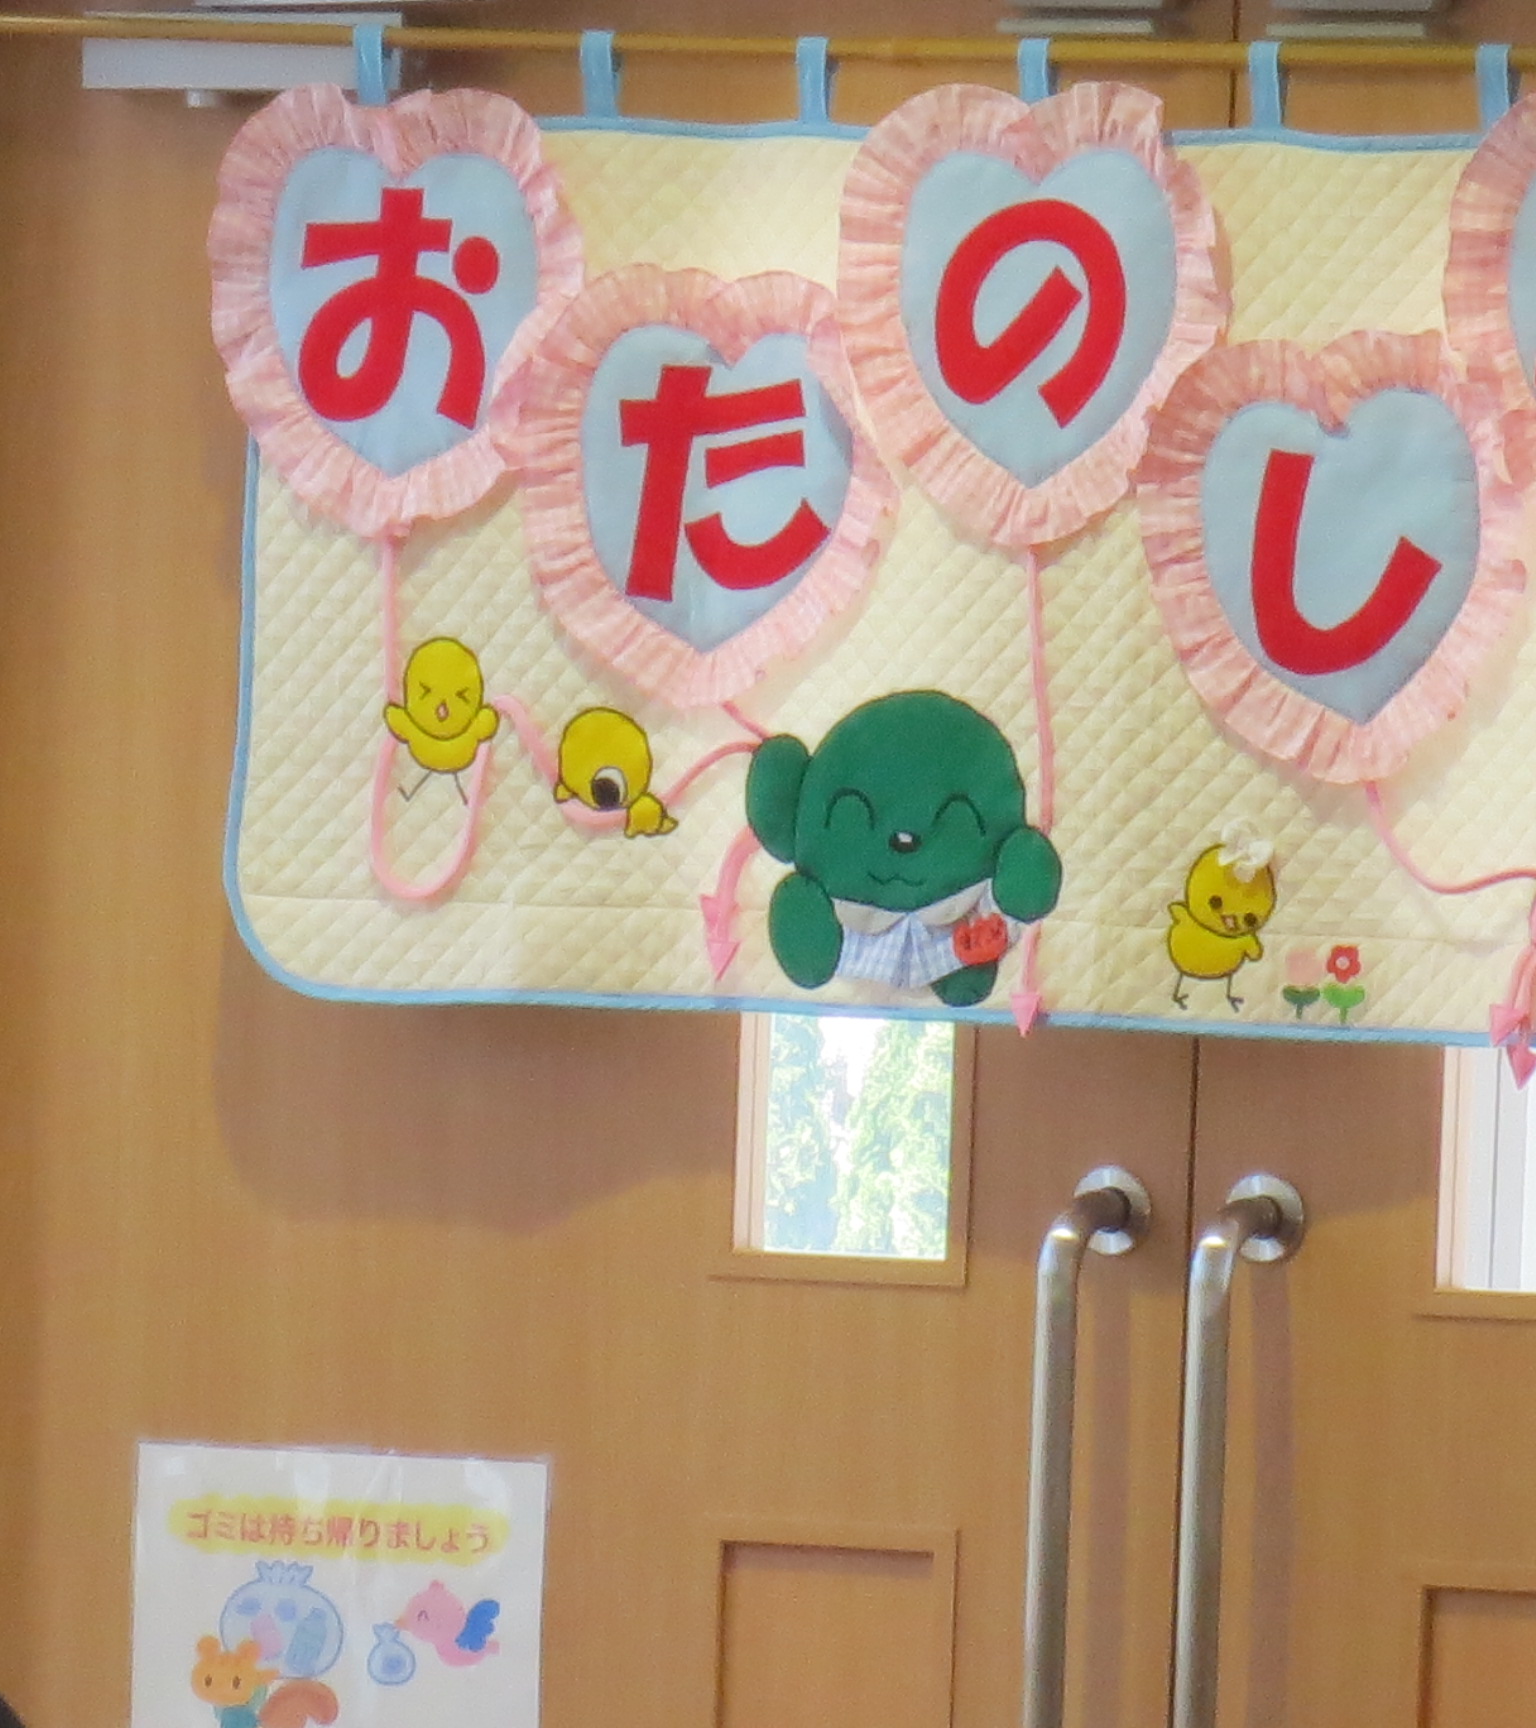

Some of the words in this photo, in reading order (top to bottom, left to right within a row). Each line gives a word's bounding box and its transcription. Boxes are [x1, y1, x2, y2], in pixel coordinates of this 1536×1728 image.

[186, 1511, 489, 1553] ゴミは持ち帰りましょう
